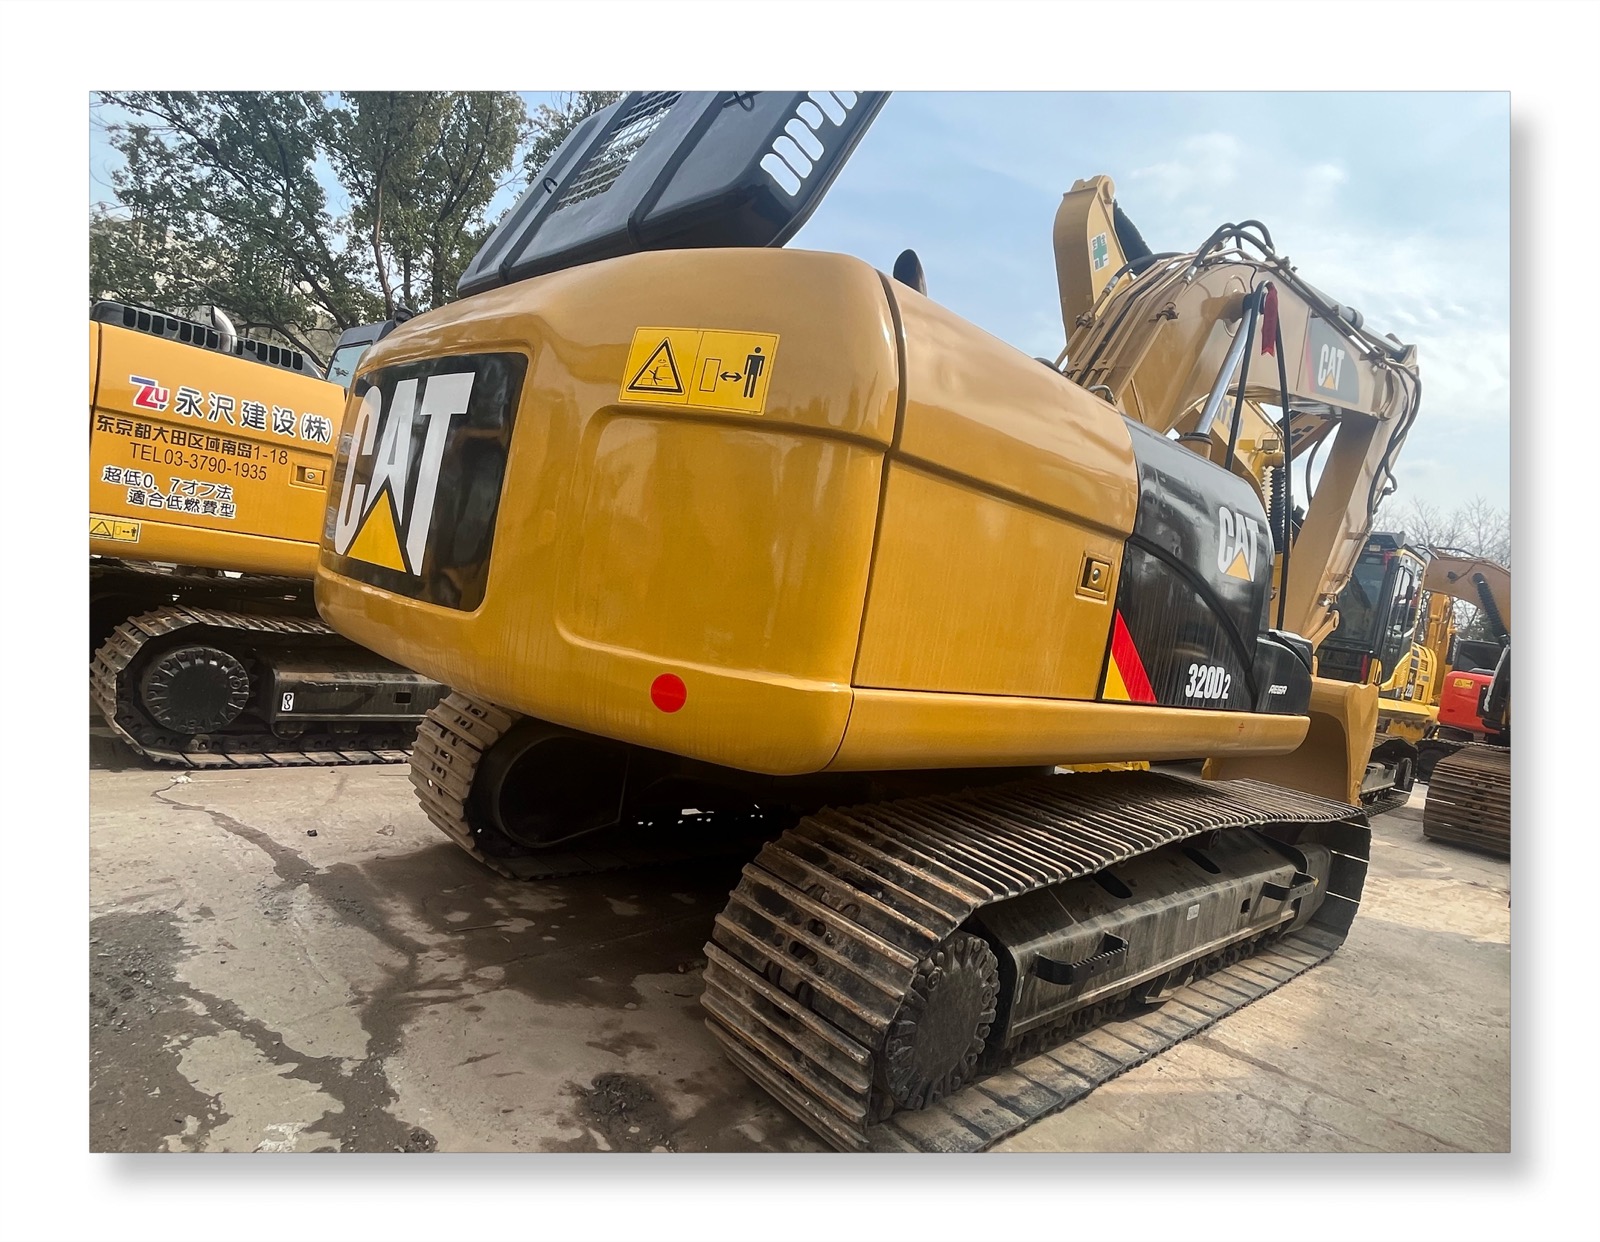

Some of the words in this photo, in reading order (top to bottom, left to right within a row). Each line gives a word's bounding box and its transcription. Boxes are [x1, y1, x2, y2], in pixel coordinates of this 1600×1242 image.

[1317, 343, 1346, 391] CAT
[334, 371, 476, 577] CAT
[1217, 506, 1260, 583] CAT
